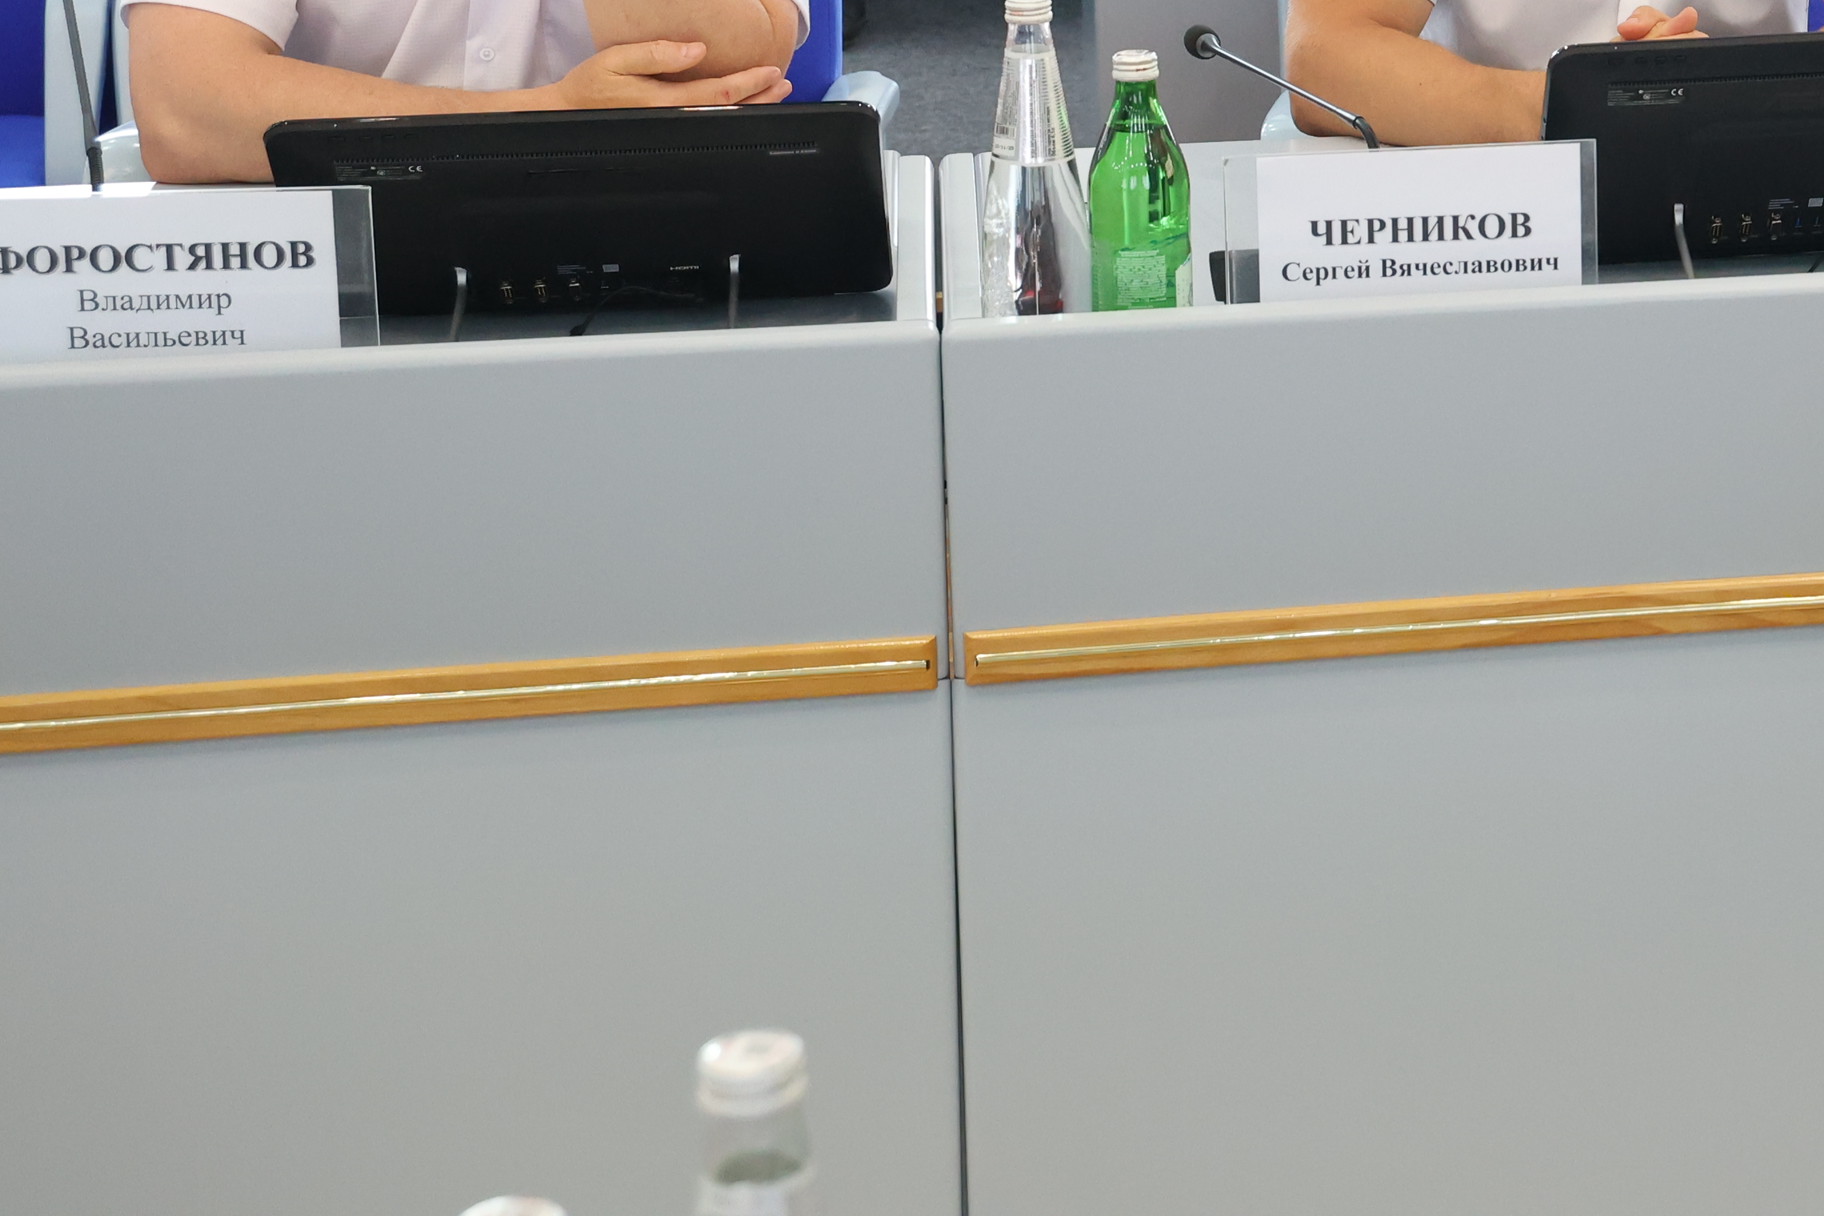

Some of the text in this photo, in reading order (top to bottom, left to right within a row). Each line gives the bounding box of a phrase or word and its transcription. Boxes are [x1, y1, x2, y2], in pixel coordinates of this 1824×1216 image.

[1308, 211, 1534, 247] ЧЕРНИКОВ
[1281, 255, 1560, 287] Сергей Вячеславович
[76, 288, 233, 316] Владимир
[66, 325, 248, 350] Васильевич
